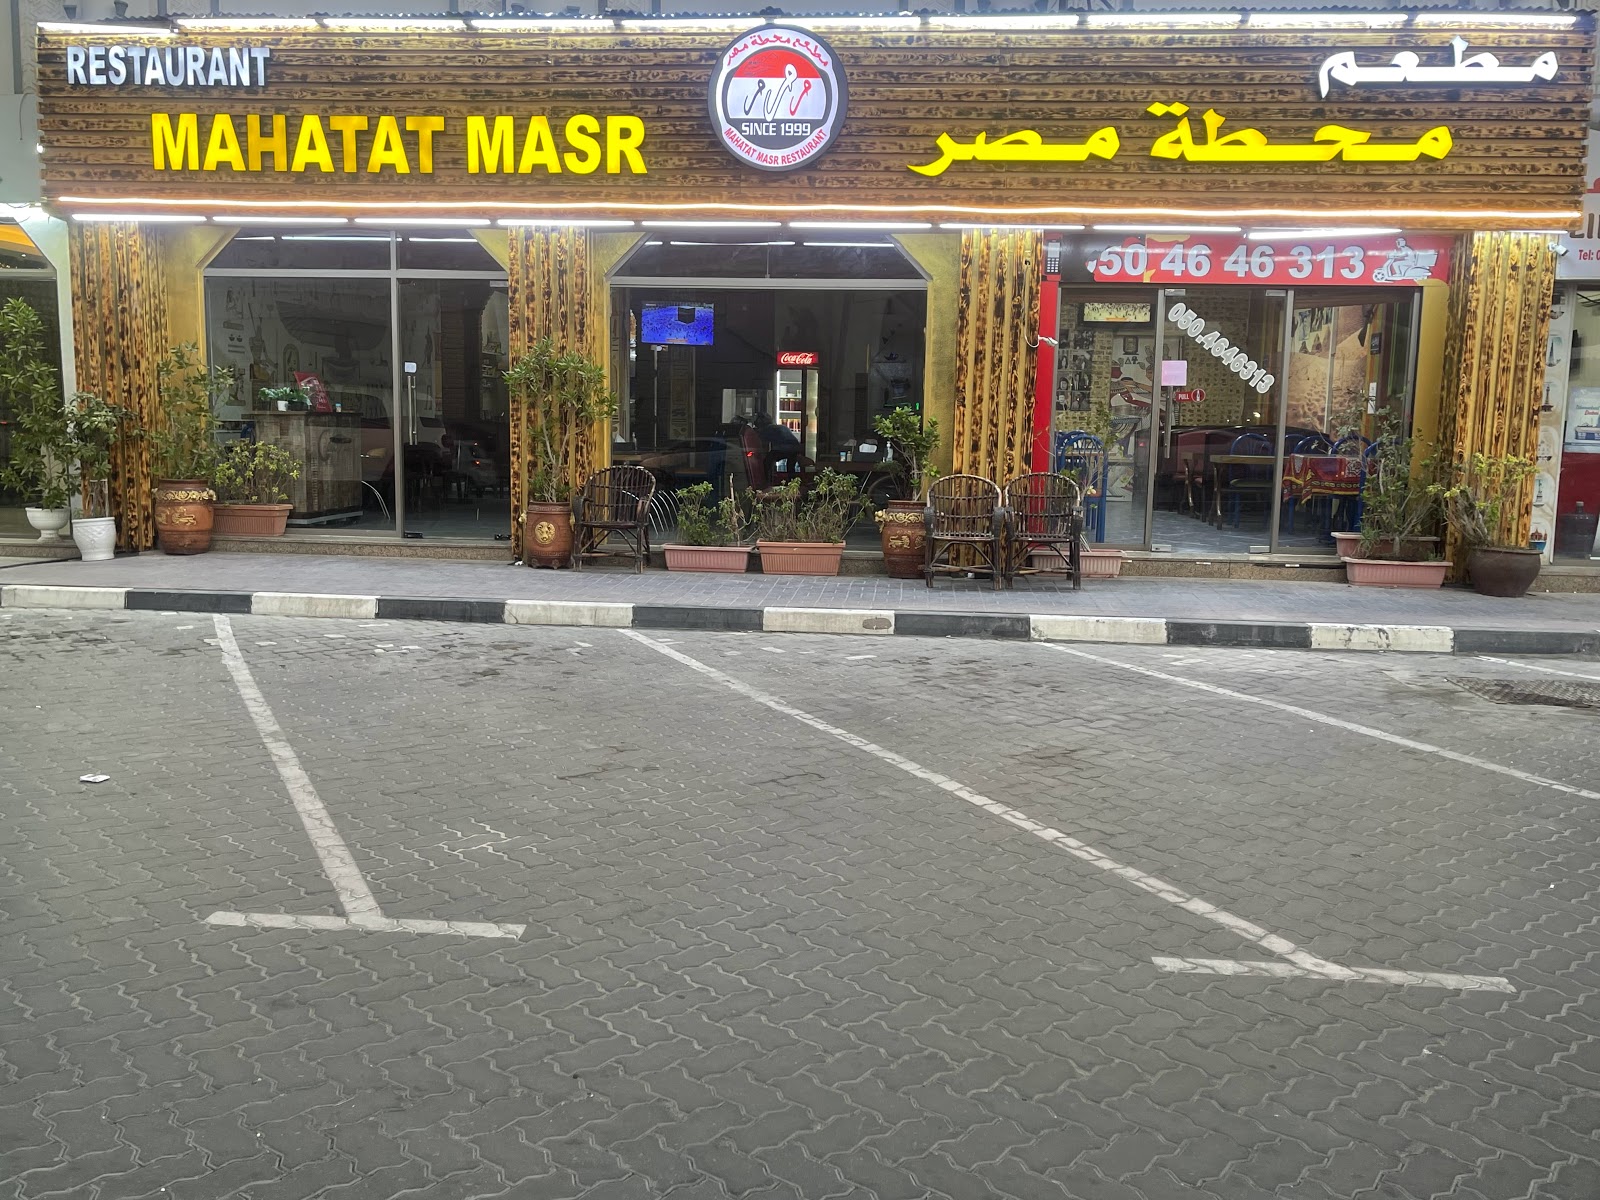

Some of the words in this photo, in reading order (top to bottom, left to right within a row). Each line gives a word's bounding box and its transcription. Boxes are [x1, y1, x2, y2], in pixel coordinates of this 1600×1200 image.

[727, 43, 749, 66] مصر
[750, 34, 791, 46] محطة
[793, 38, 829, 66] مطعم
[66, 45, 271, 87] RESTAURANT
[1318, 35, 1559, 99] مطعم
[150, 112, 446, 174] MAHATAT
[466, 113, 649, 175] MASR
[723, 127, 758, 158] MAHATAT
[755, 151, 780, 165] MASR
[781, 128, 828, 165] RESTAURANT
[741, 122, 777, 136] SINCE
[780, 122, 811, 136] 1999
[1146, 101, 1454, 162] محطة
[906, 126, 1121, 177] مصر
[1160, 244, 1212, 278] 46
[1223, 244, 1275, 279] 46
[1287, 244, 1366, 280] 313
[1578, 249, 1594, 261] Tel:
[1167, 302, 1275, 394] 050.4646313
